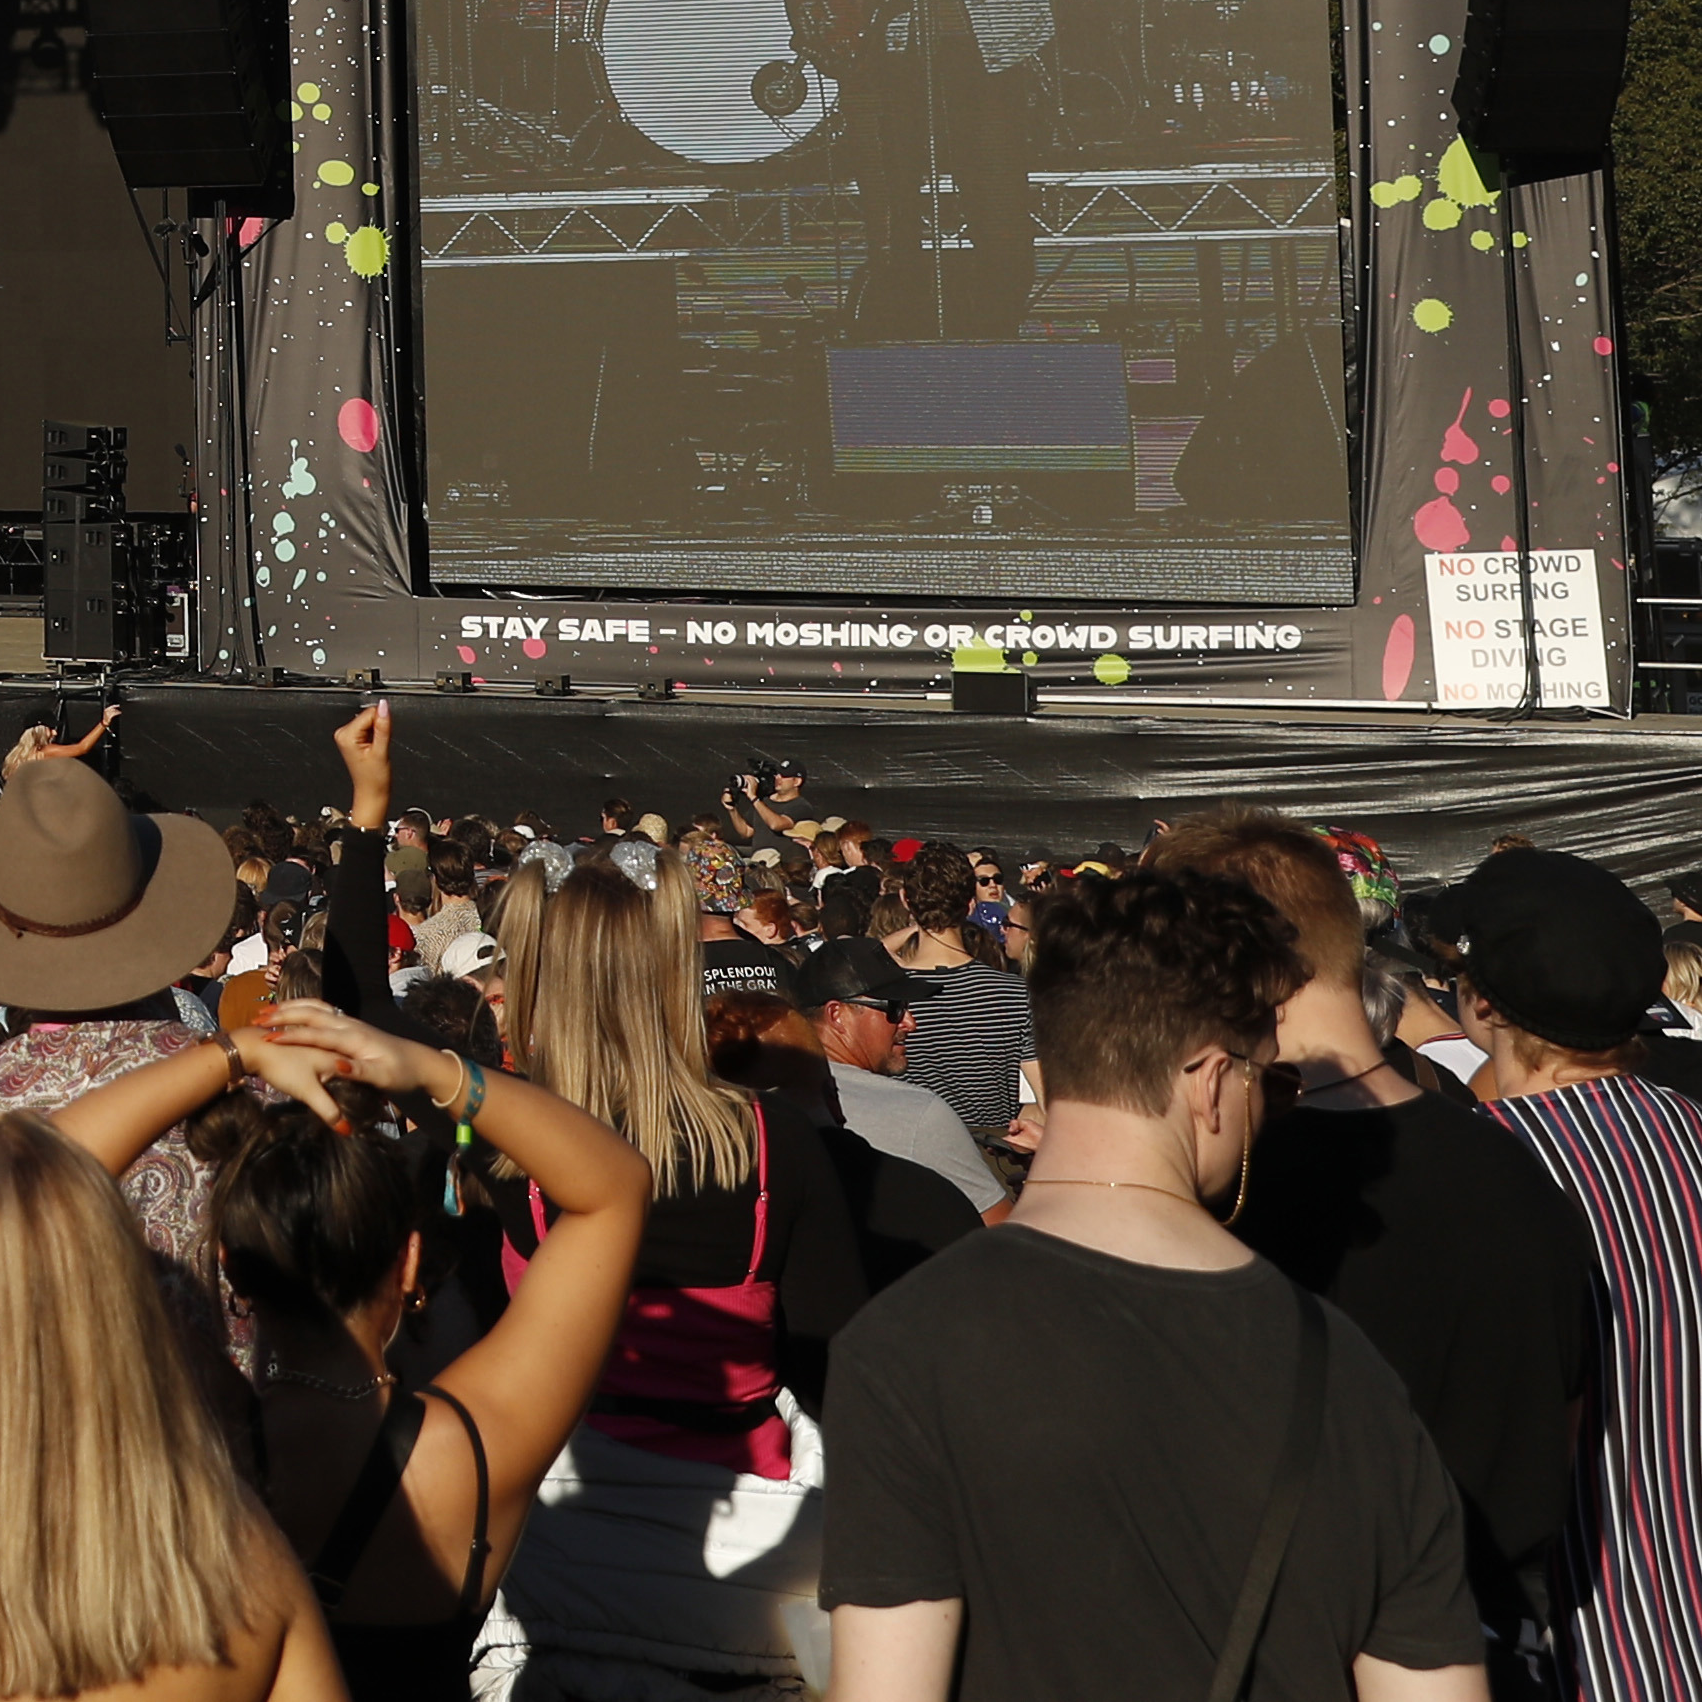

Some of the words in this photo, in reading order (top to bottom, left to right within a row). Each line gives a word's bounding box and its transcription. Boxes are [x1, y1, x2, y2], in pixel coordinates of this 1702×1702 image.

[1438, 558, 1475, 576] NO
[1455, 581, 1569, 602] SURFNG
[460, 616, 549, 640] STAY
[558, 618, 650, 642] SAFE
[686, 621, 736, 645] NO
[747, 621, 914, 647] MOSHING
[924, 625, 975, 648] OR
[983, 625, 1118, 649] CROWD
[1128, 624, 1303, 649] SURFING
[1444, 619, 1485, 640] NO
[1494, 617, 1589, 639] STAGE
[1470, 647, 1567, 669] DIVIG
[1443, 683, 1479, 701] NO
[1486, 681, 1603, 701] MOHING
[717, 980, 744, 992] THE
[746, 978, 777, 991] GRA
